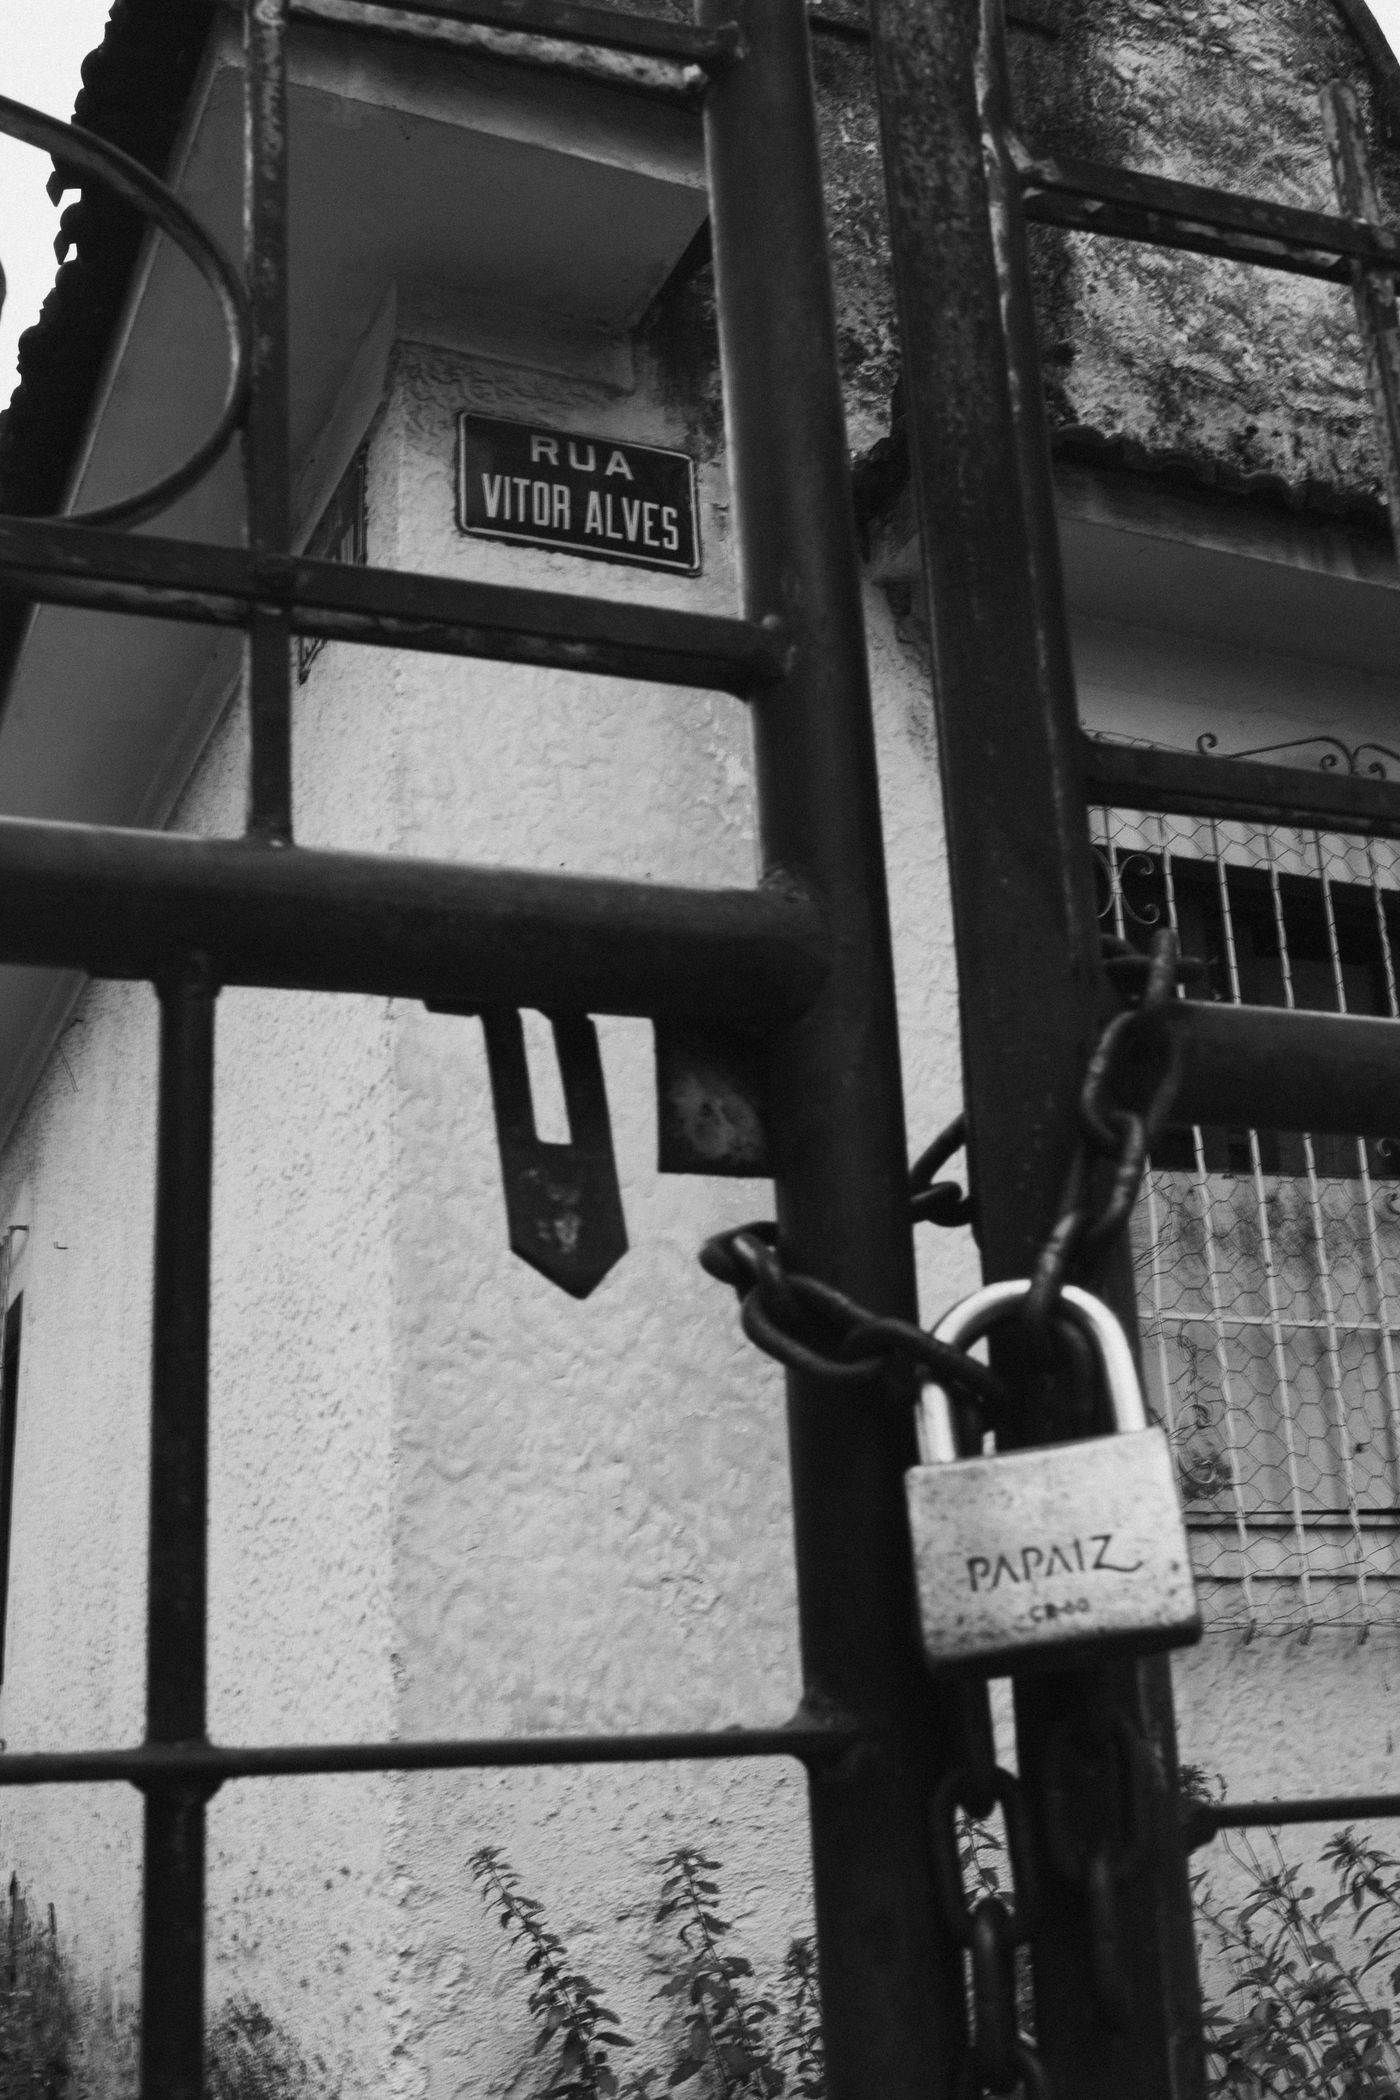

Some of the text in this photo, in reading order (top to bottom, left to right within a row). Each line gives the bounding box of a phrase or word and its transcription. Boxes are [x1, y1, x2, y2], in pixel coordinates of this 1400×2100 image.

[530, 435, 634, 481] RUA
[482, 473, 679, 551] VITOR ALVES
[966, 1534, 1144, 1592] PAPAIZ
